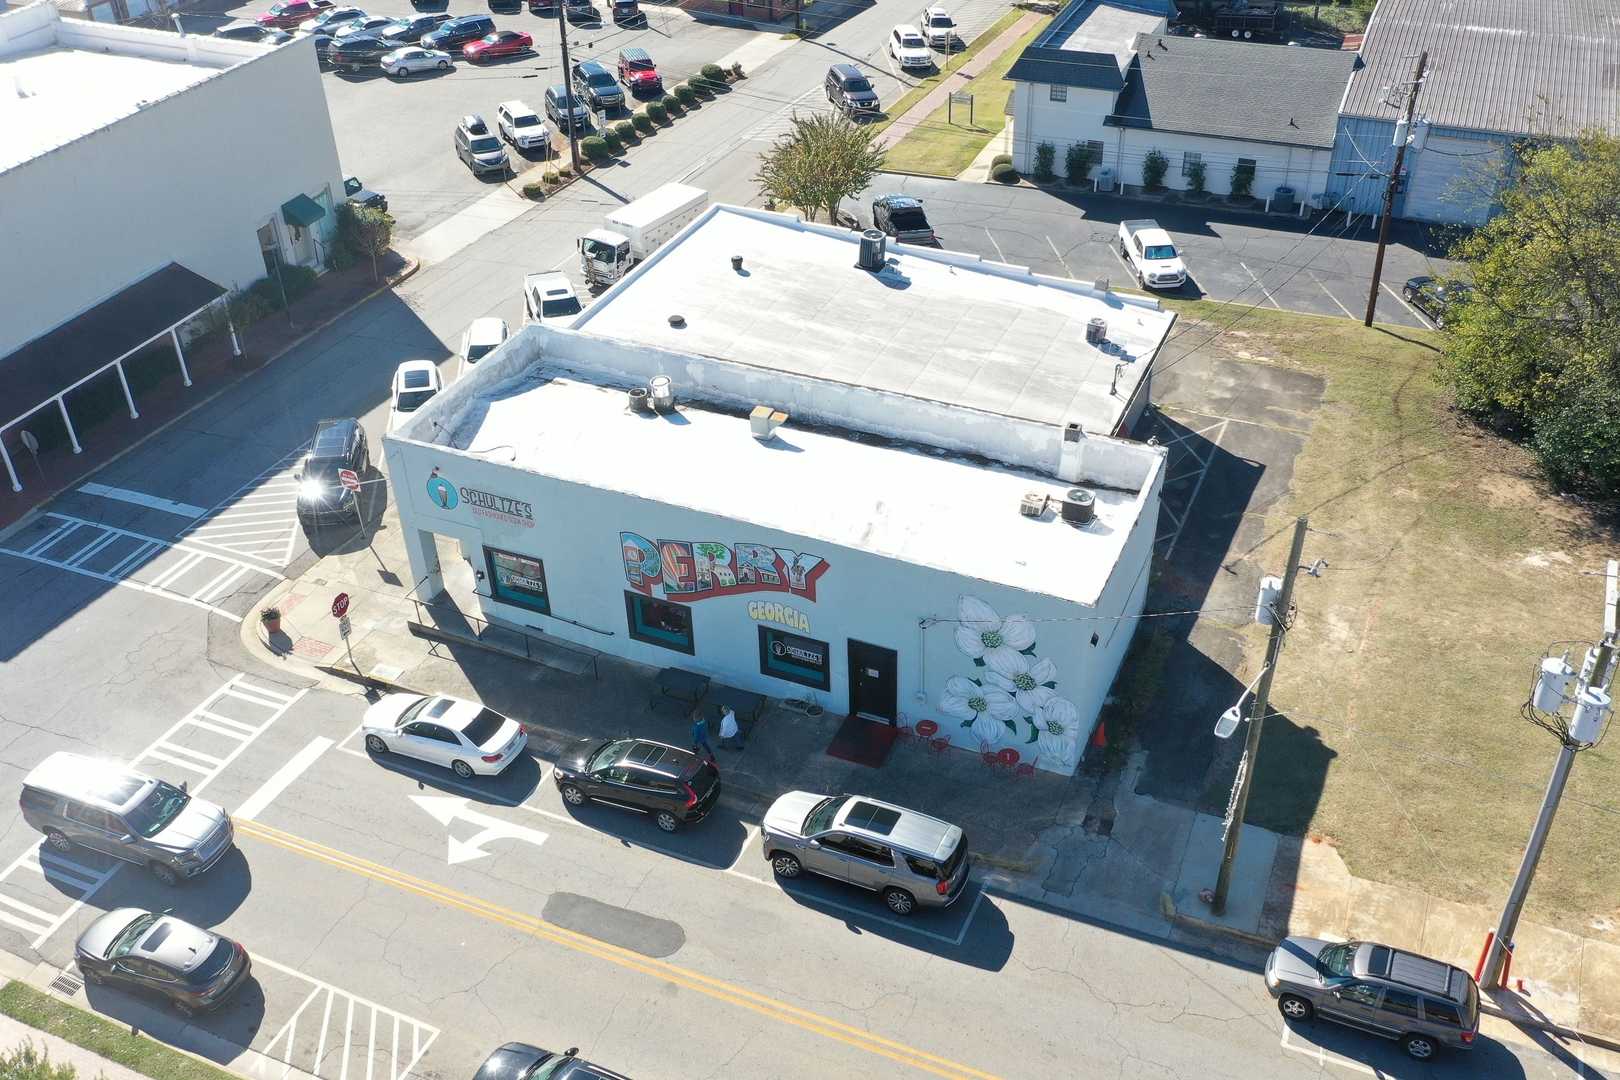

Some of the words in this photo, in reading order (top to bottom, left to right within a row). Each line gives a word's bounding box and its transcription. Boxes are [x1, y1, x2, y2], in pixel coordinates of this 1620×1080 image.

[620, 531, 829, 601] PERRY
[332, 597, 348, 614] STOP
[747, 600, 811, 633] GEORGIA
